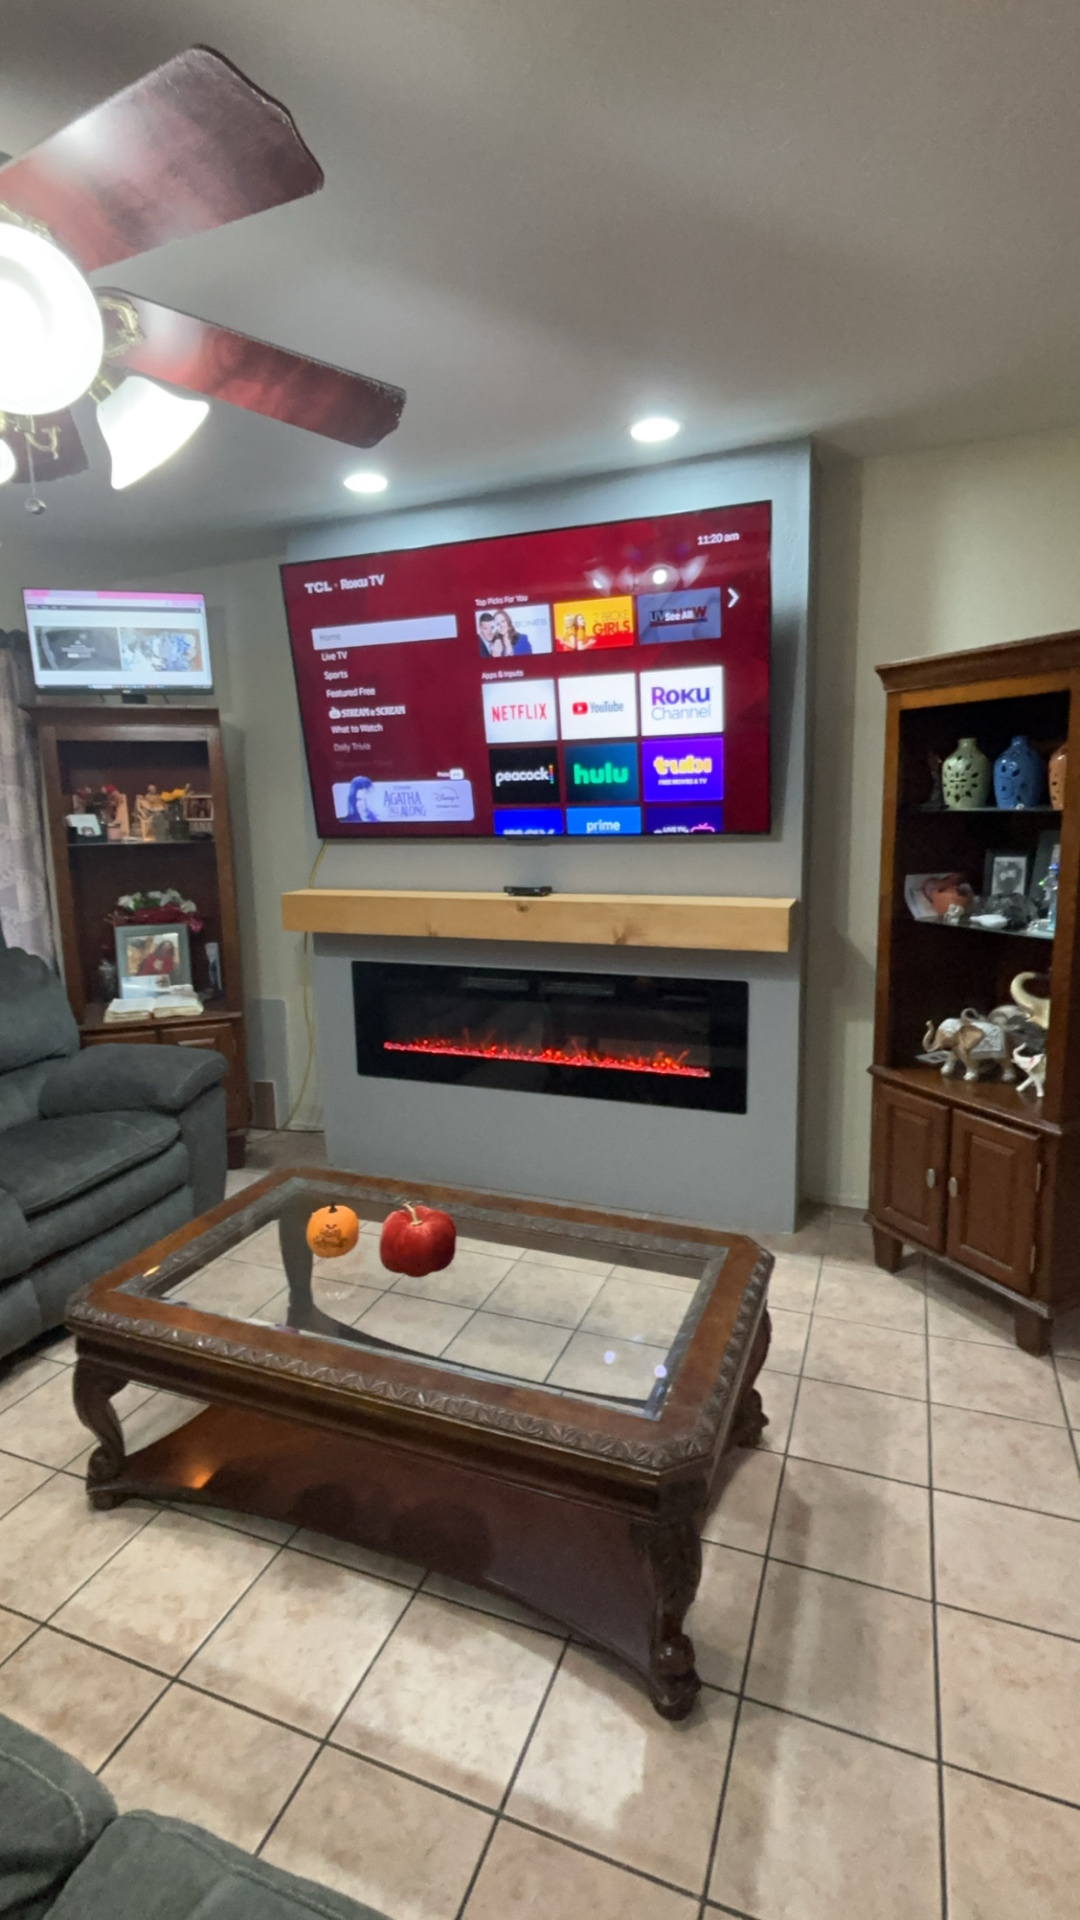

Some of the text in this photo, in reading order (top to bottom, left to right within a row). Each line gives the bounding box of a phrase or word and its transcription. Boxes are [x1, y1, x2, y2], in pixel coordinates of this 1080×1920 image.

[697, 533, 740, 546] 11:20 am
[304, 581, 332, 594] TCL
[368, 574, 385, 587] TV
[665, 612, 680, 622] See
[592, 619, 631, 635] GIRLS
[319, 633, 342, 641] Home
[321, 650, 348, 661] Live TV
[323, 670, 348, 681] Sports
[326, 686, 376, 698] Featured Free
[651, 686, 711, 706] Roku
[491, 703, 547, 722] NETFLIX
[590, 700, 624, 714] YouTube
[651, 704, 711, 721] Channel
[331, 723, 384, 734] What to Watch
[495, 766, 549, 787] peacock
[573, 762, 630, 785] hulu
[384, 790, 422, 807] AGATHA
[401, 805, 427, 817] ALONG
[586, 819, 621, 834] prime
